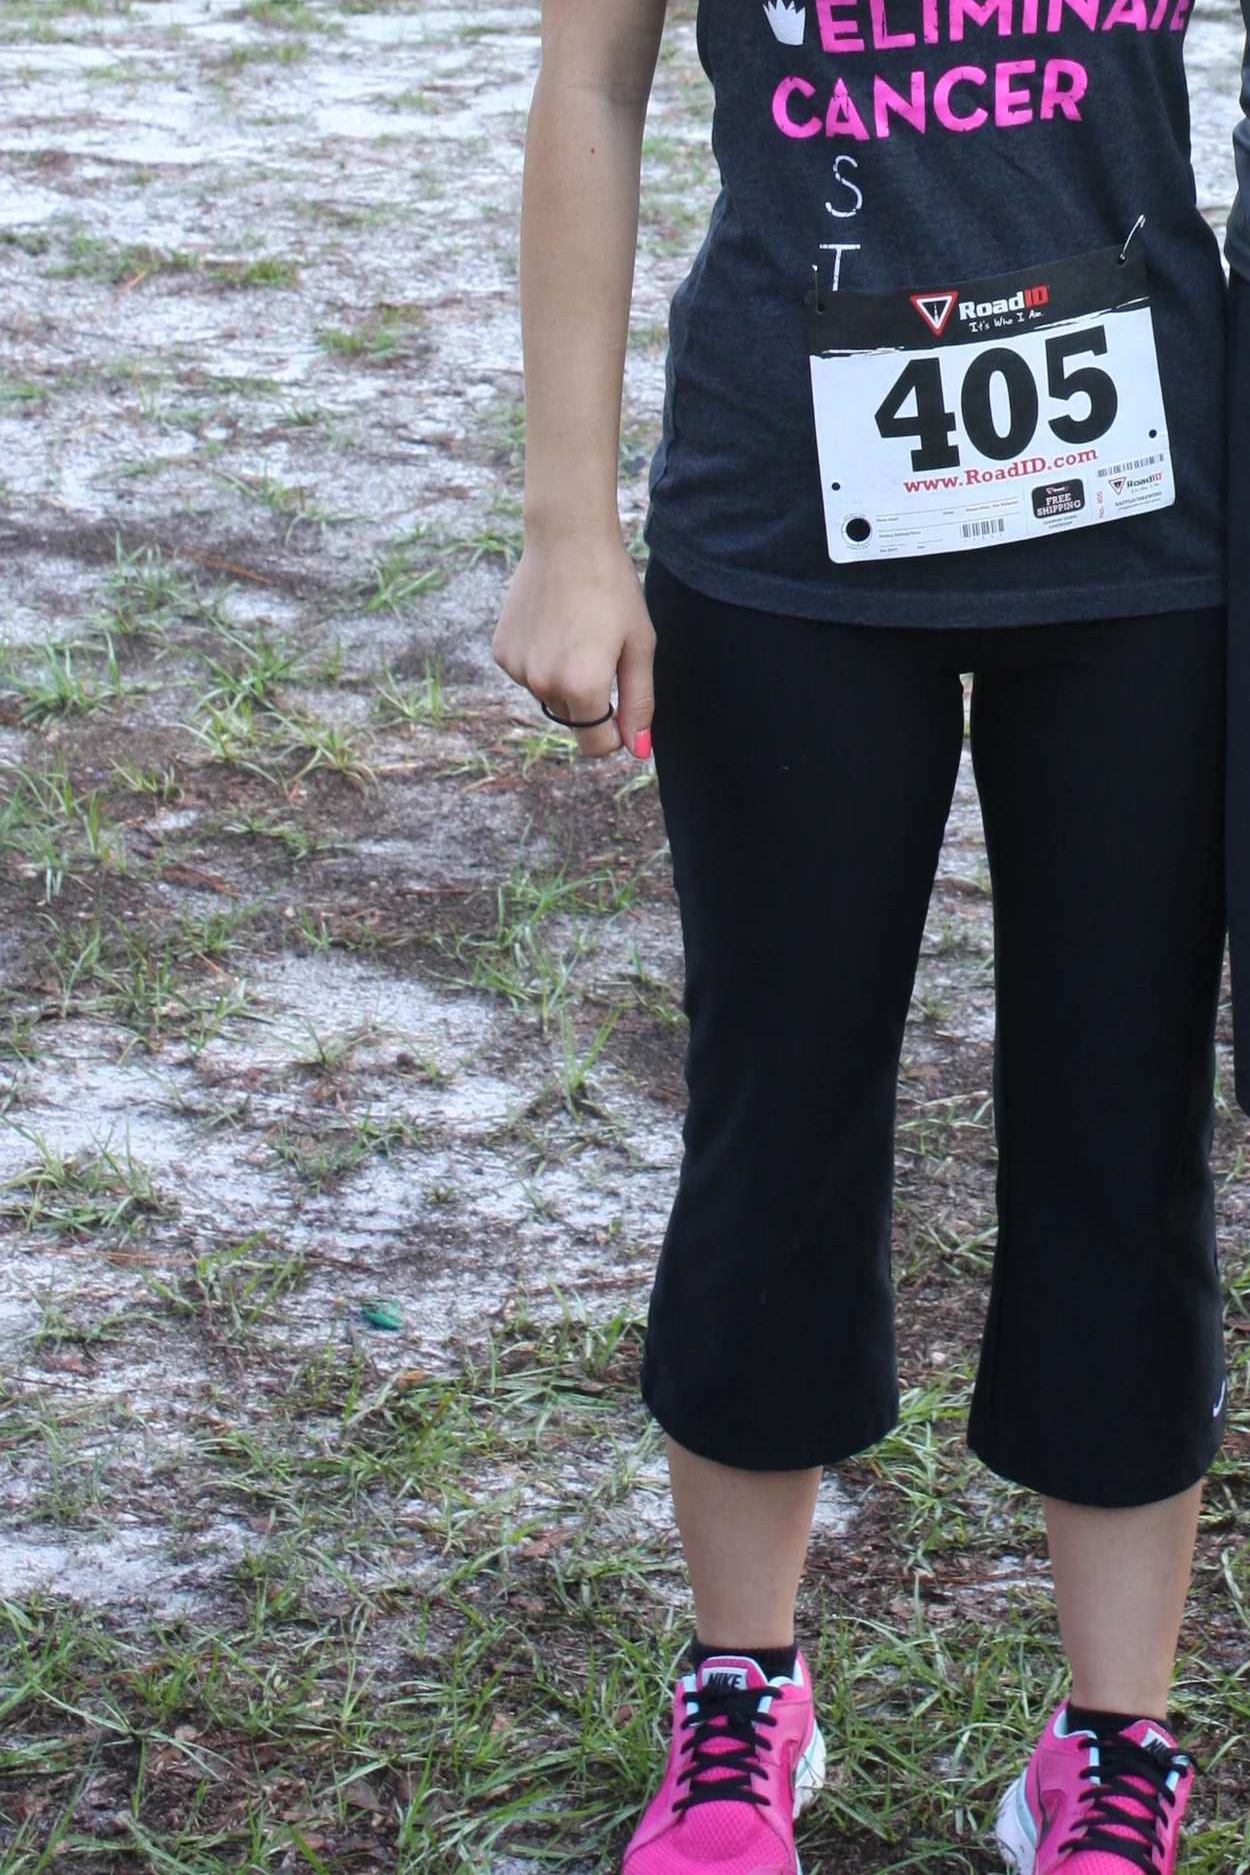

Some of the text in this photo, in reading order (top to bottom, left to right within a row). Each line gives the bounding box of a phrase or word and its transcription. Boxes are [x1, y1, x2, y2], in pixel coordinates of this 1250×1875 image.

[771, 57, 1089, 141] CANCER
[968, 319, 990, 333] It's
[994, 317, 1013, 328] Who
[1017, 312, 1025, 323] I
[874, 324, 1118, 473] 405
[904, 448, 1098, 494] www.RoadID.com
[1036, 499, 1082, 517] SHIPPING
[1046, 492, 1072, 506] FREE
